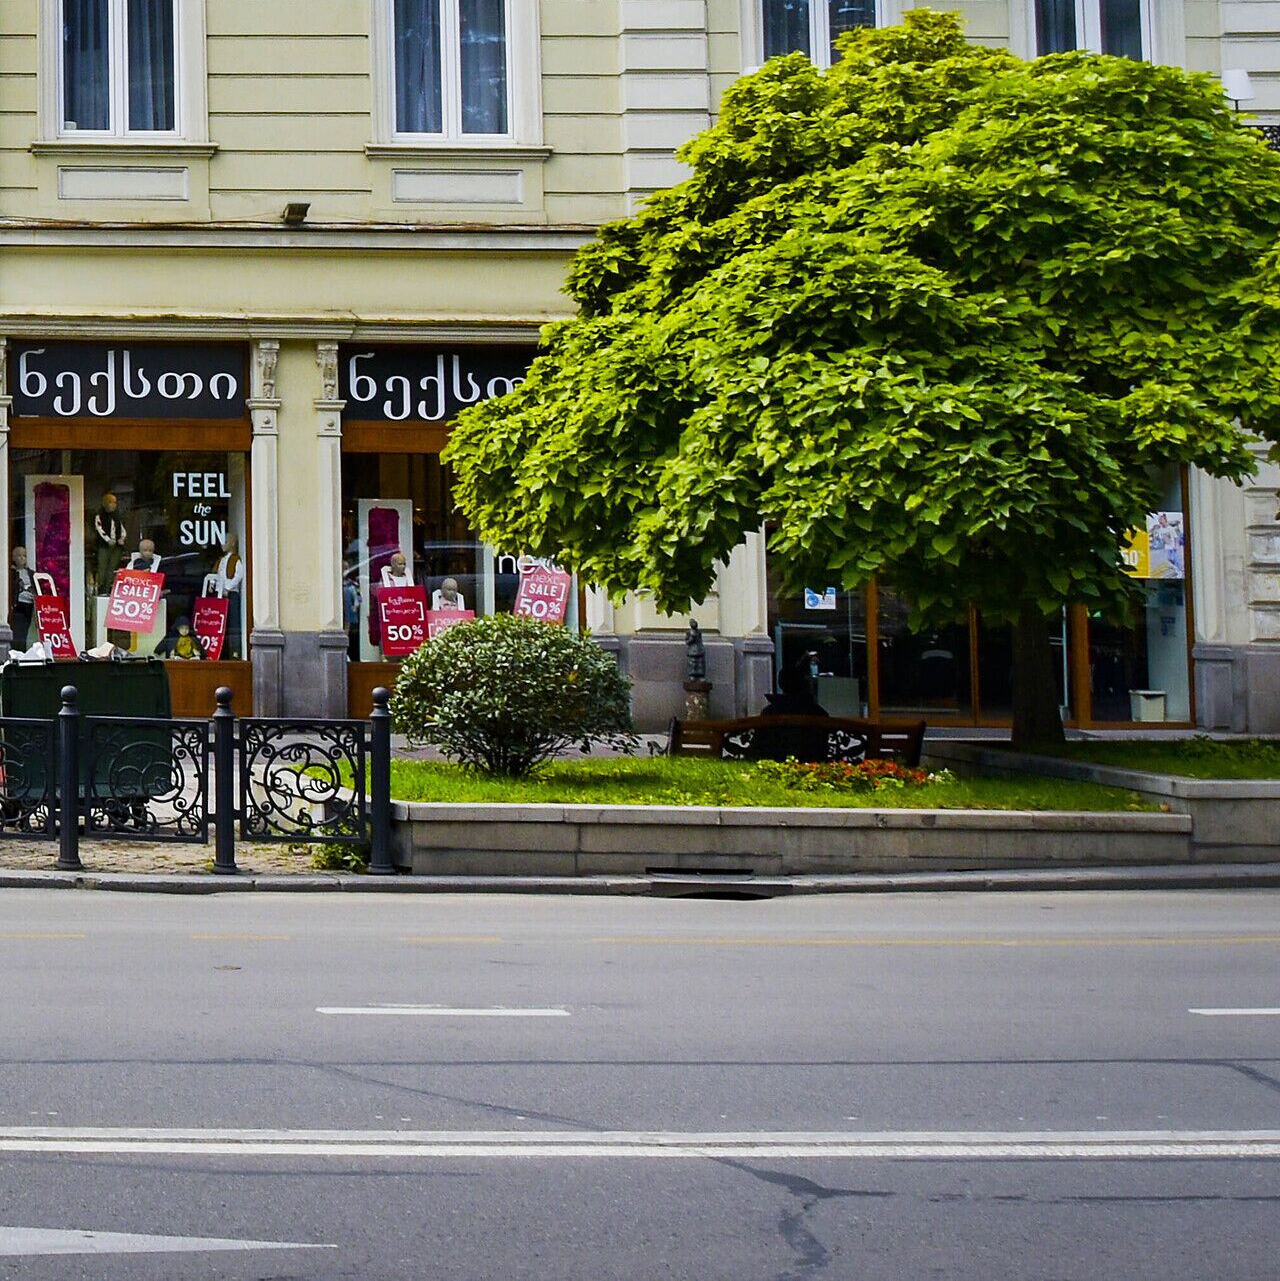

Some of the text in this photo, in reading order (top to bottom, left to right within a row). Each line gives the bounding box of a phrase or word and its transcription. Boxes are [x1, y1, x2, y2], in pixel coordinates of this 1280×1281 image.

[19, 348, 238, 417] ნექსთი
[173, 472, 232, 498] FEEL
[193, 502, 212, 517] the
[180, 520, 226, 546] SUN
[123, 576, 152, 587] next
[528, 583, 558, 597] SALE
[120, 584, 151, 598] SALE
[110, 600, 154, 618] 50%
[387, 624, 424, 641] 50%
